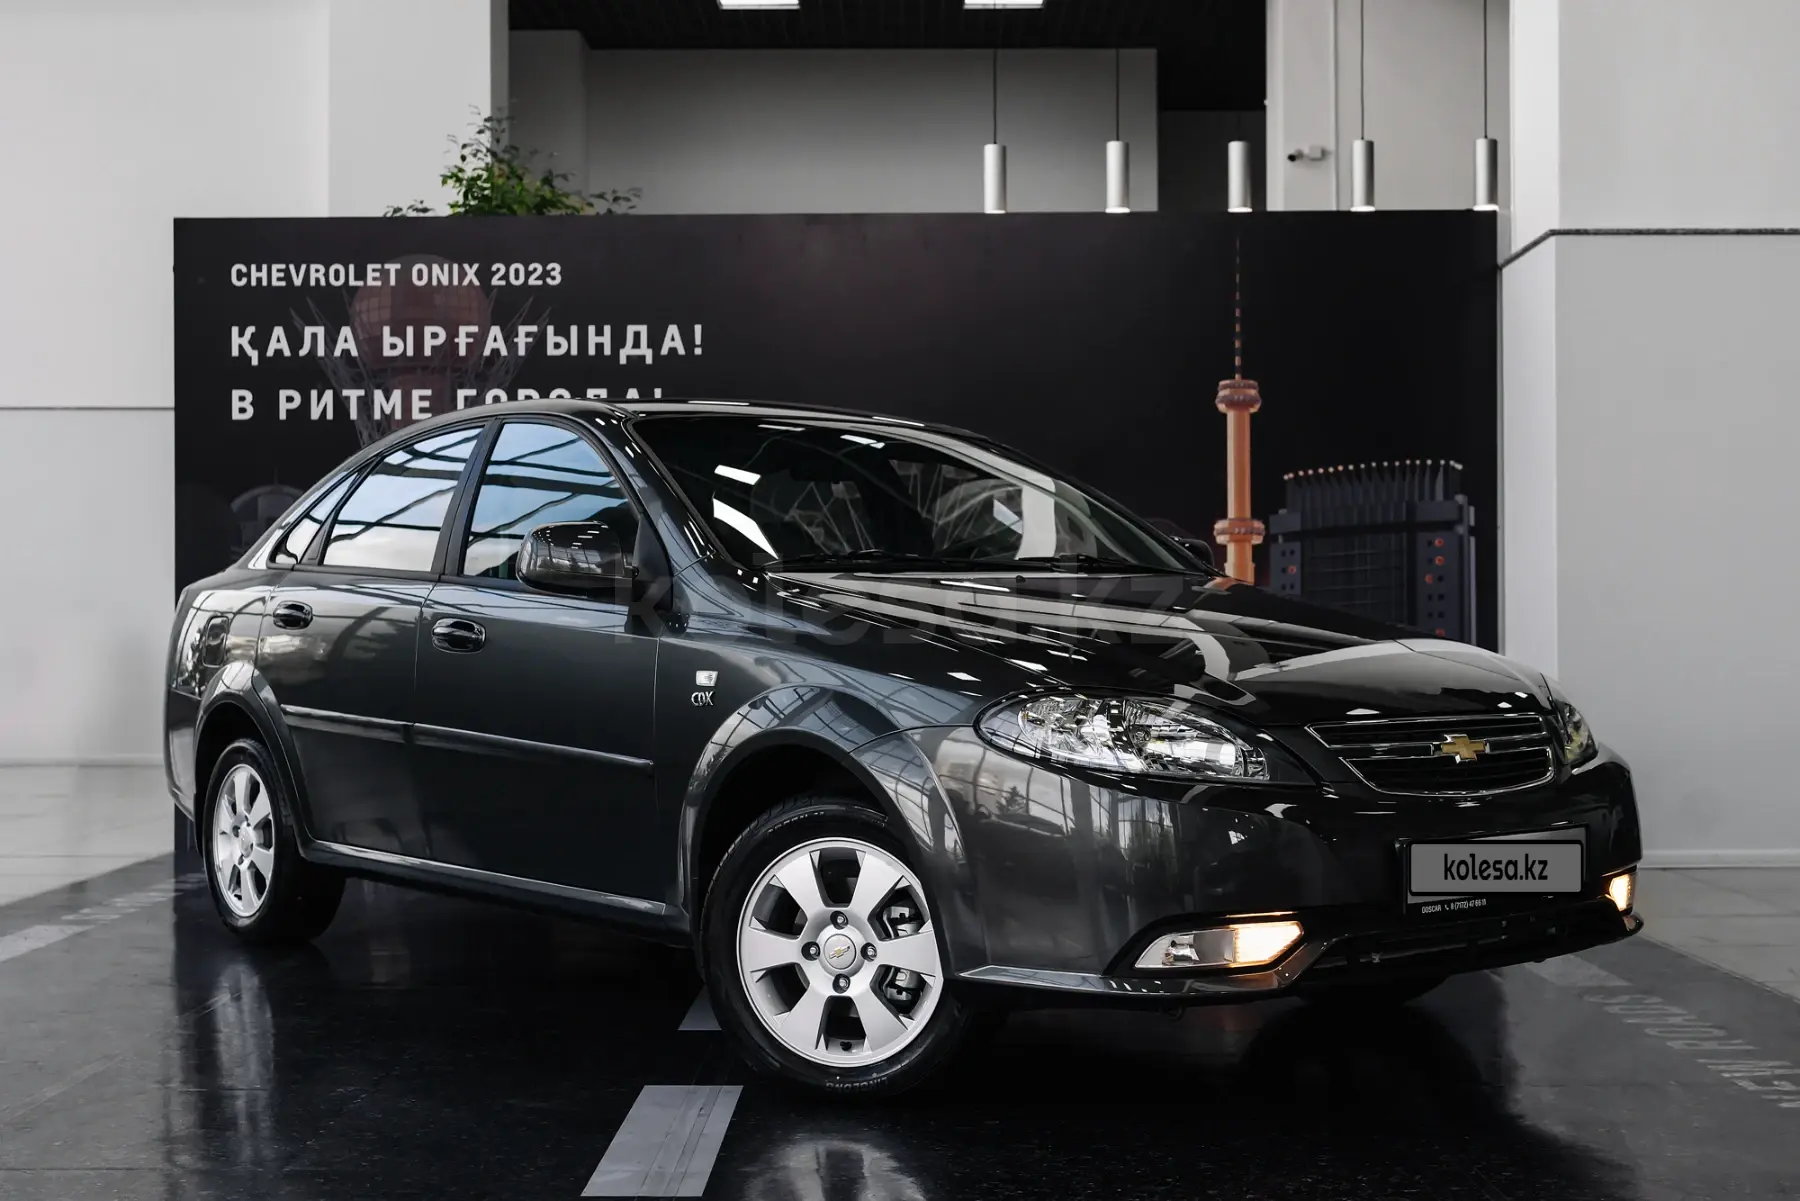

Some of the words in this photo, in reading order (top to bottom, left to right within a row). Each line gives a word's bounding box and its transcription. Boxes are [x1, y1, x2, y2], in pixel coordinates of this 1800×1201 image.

[230, 263, 402, 287] CHEVROLET
[411, 263, 481, 287] ONIX
[490, 262, 562, 286] 2023
[231, 325, 359, 366] ҚАЛА
[382, 324, 702, 365] ЫРҒАҒЫНДА!
[231, 389, 254, 421] В
[279, 388, 433, 421] РИТМЕ
[1582, 994, 1762, 1050] ROADS
